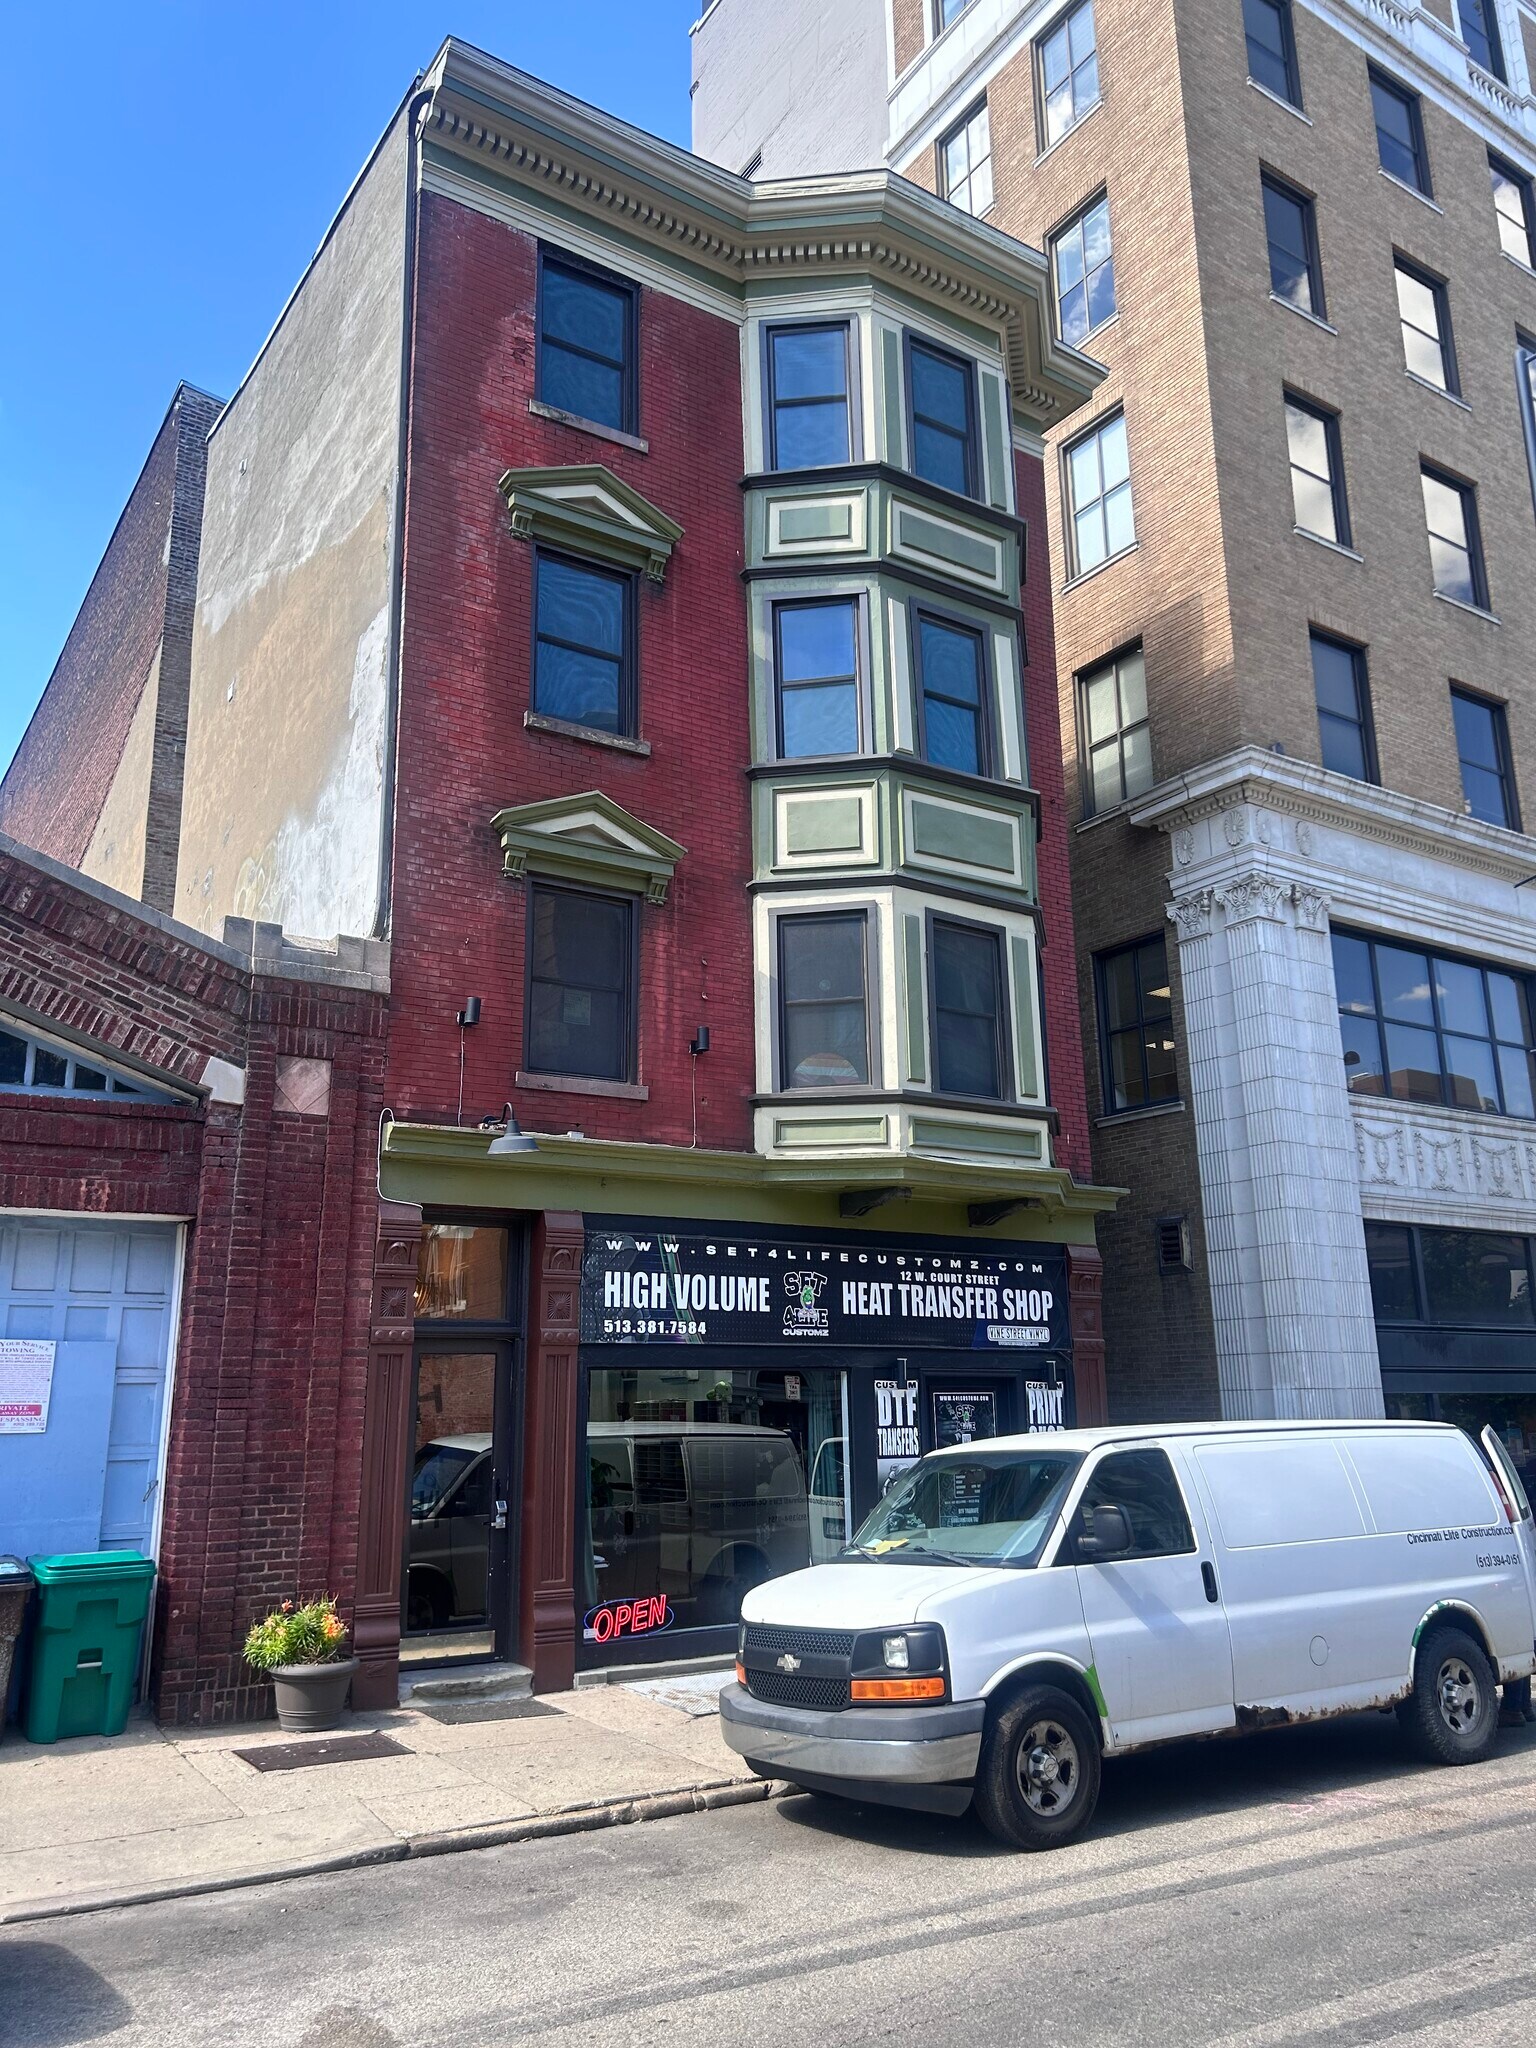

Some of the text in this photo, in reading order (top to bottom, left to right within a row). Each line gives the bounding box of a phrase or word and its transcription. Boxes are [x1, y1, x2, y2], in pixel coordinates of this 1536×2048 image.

[606, 1240, 1043, 1273] WWW.SET4LIFECUSTOMZ.COM
[604, 1271, 770, 1312] HIGH VOLUME
[783, 1271, 828, 1297] SET
[900, 1271, 999, 1285] 12 W. COURT STREET
[842, 1281, 1053, 1321] HEAT TRANSFER SHOP
[604, 1319, 707, 1335] 513.381.7584
[783, 1329, 829, 1337] CUSTOMZ
[990, 1327, 1048, 1340] VINE STREET VINYL
[877, 1390, 917, 1427] DTF
[1029, 1390, 1064, 1424] PRINT
[877, 1427, 919, 1456] TRANSFERS
[1407, 1532, 1442, 1544] Cincinnati
[1443, 1529, 1460, 1541] Elite
[593, 1594, 667, 1643] OPEN
